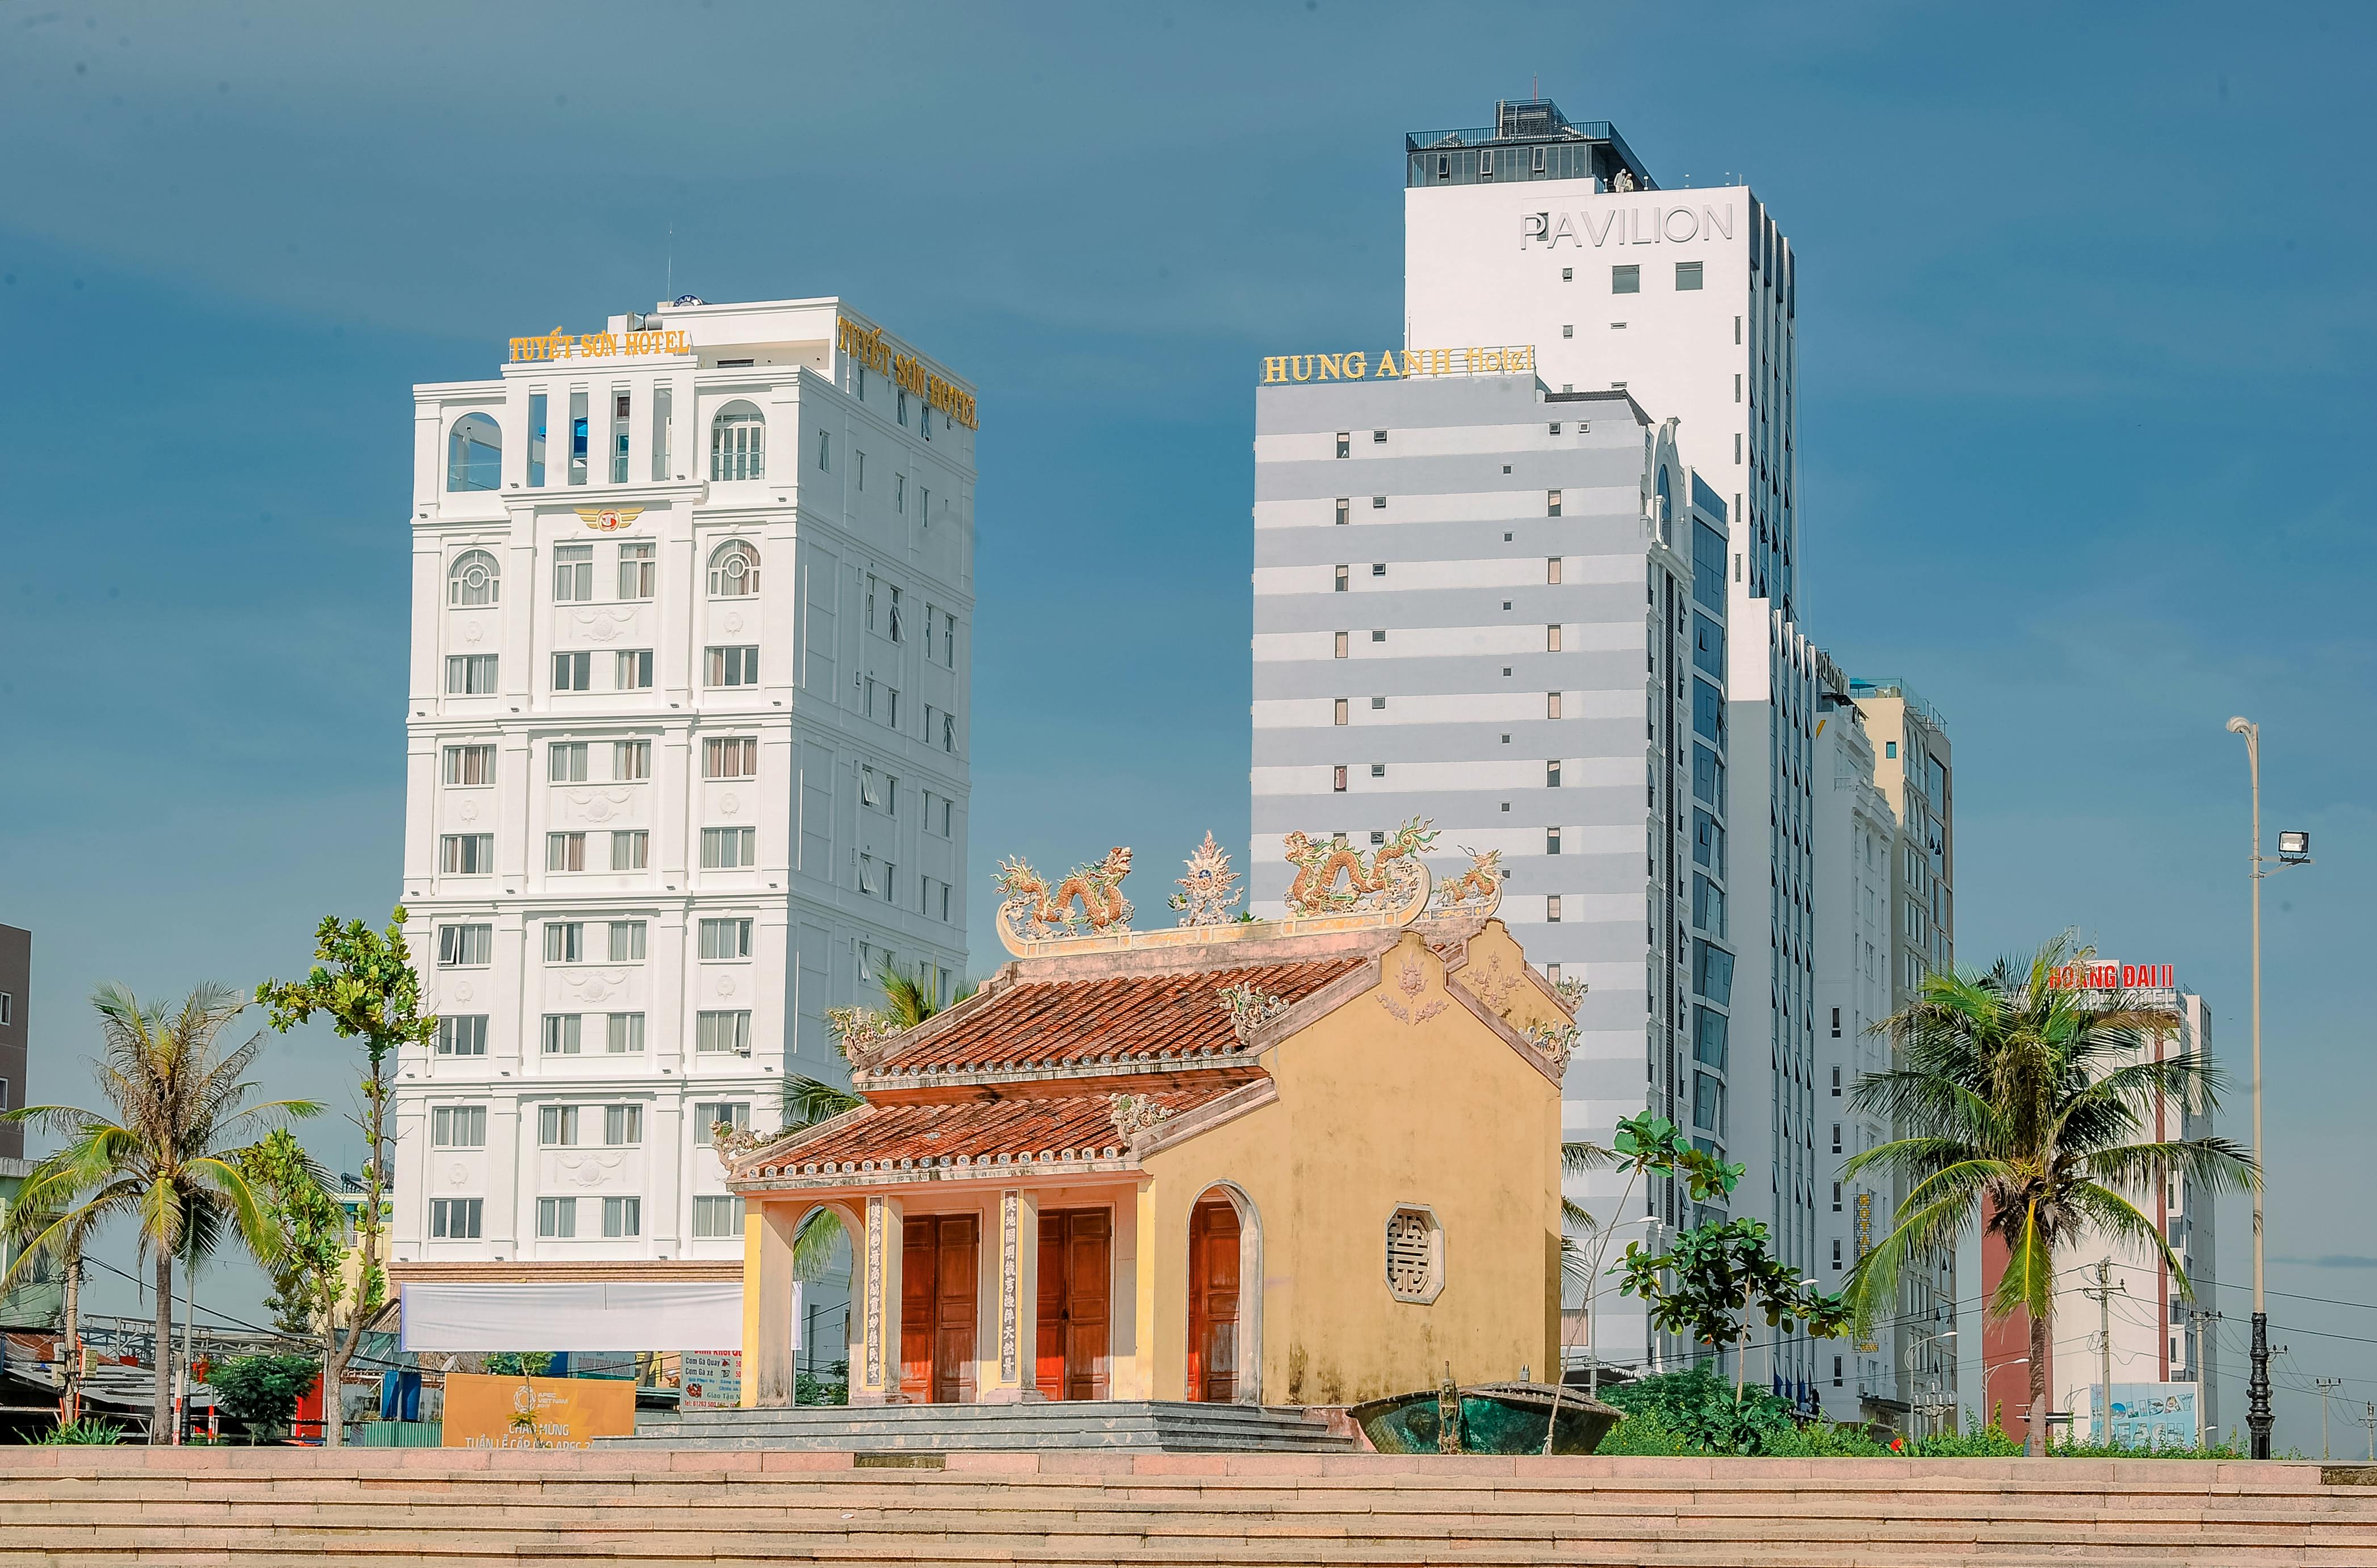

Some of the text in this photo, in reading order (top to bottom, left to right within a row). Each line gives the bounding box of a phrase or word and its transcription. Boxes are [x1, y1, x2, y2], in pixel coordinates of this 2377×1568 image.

[1521, 203, 1733, 250] PAVILION
[509, 326, 690, 361] TUYẾT SƠN HOTEL
[837, 316, 980, 431] TUYẾT SƠN HOTEL
[1264, 345, 1532, 383] HUNG ANH Hotel
[707, 1358, 720, 1366] Quay
[2091, 1394, 2195, 1423] HOLIDAY
